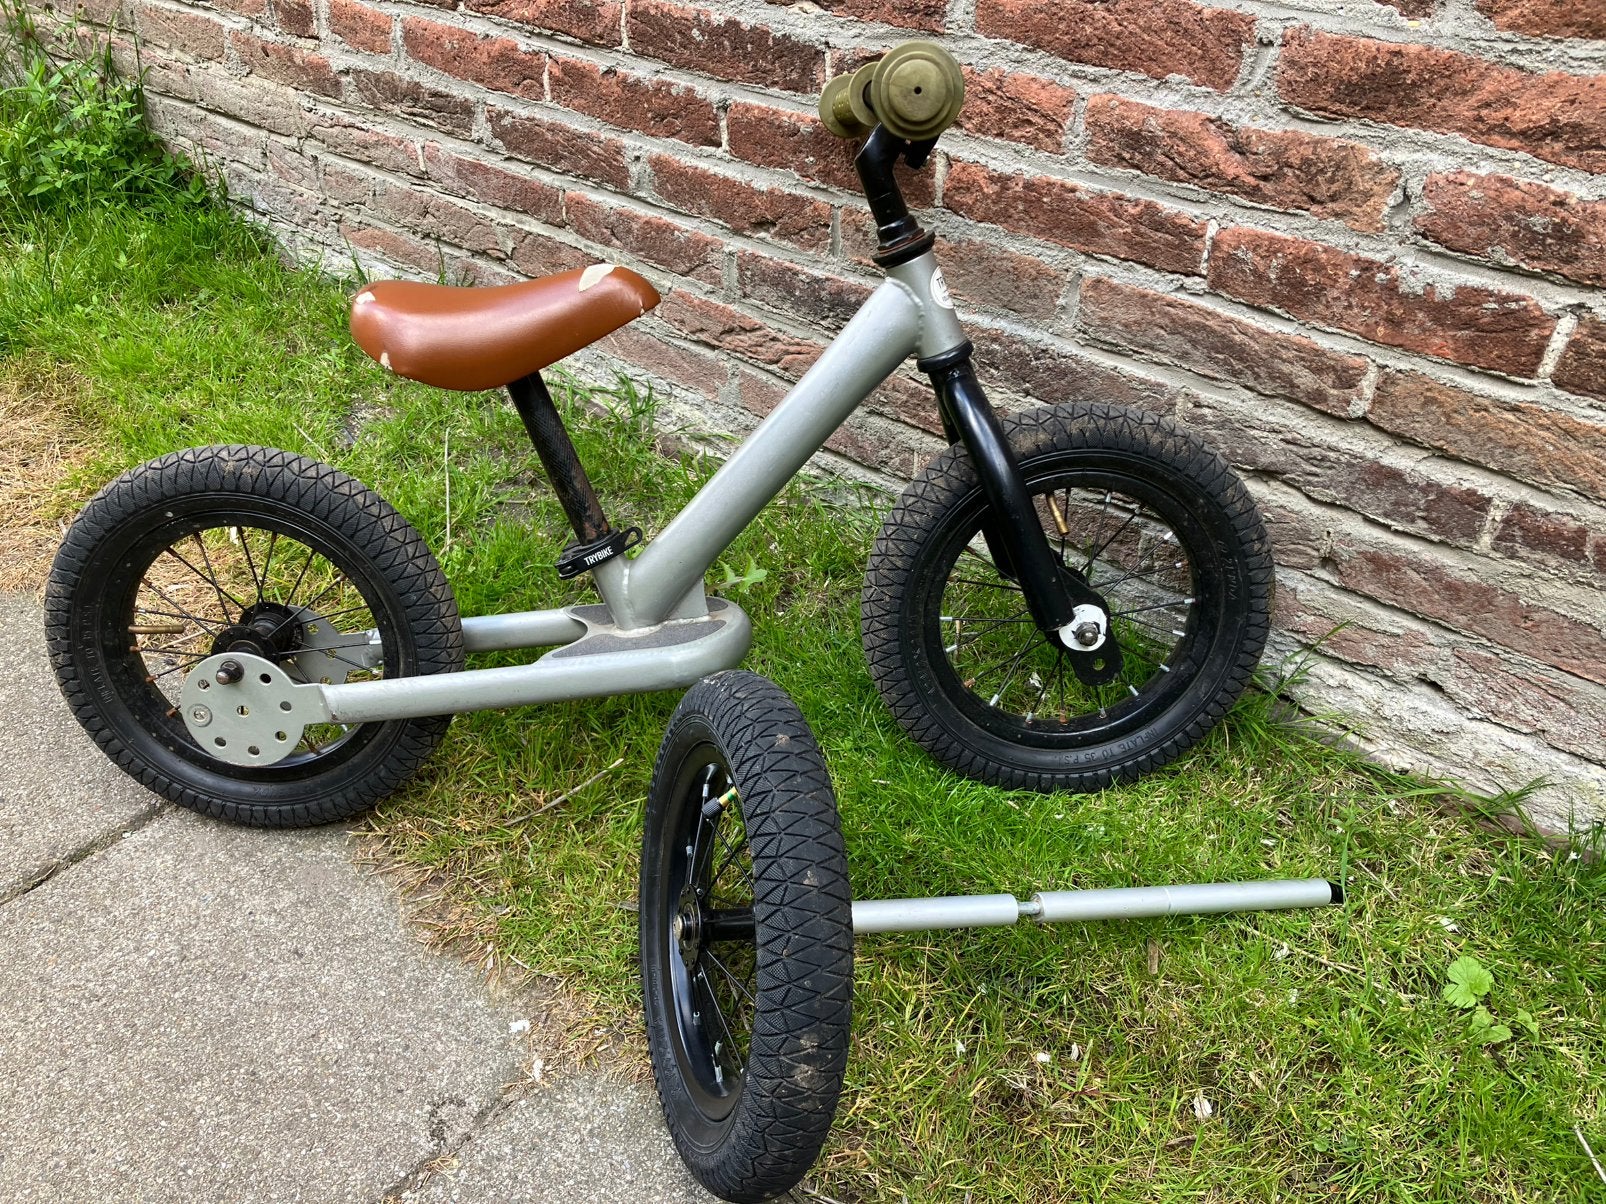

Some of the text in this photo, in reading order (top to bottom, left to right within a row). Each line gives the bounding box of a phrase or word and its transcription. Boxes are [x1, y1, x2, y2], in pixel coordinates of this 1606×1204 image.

[583, 546, 614, 566] TRYBIKE
[1119, 728, 1158, 753] INFLATE
[1085, 752, 1096, 762] 35
[1102, 747, 1113, 758] TO
